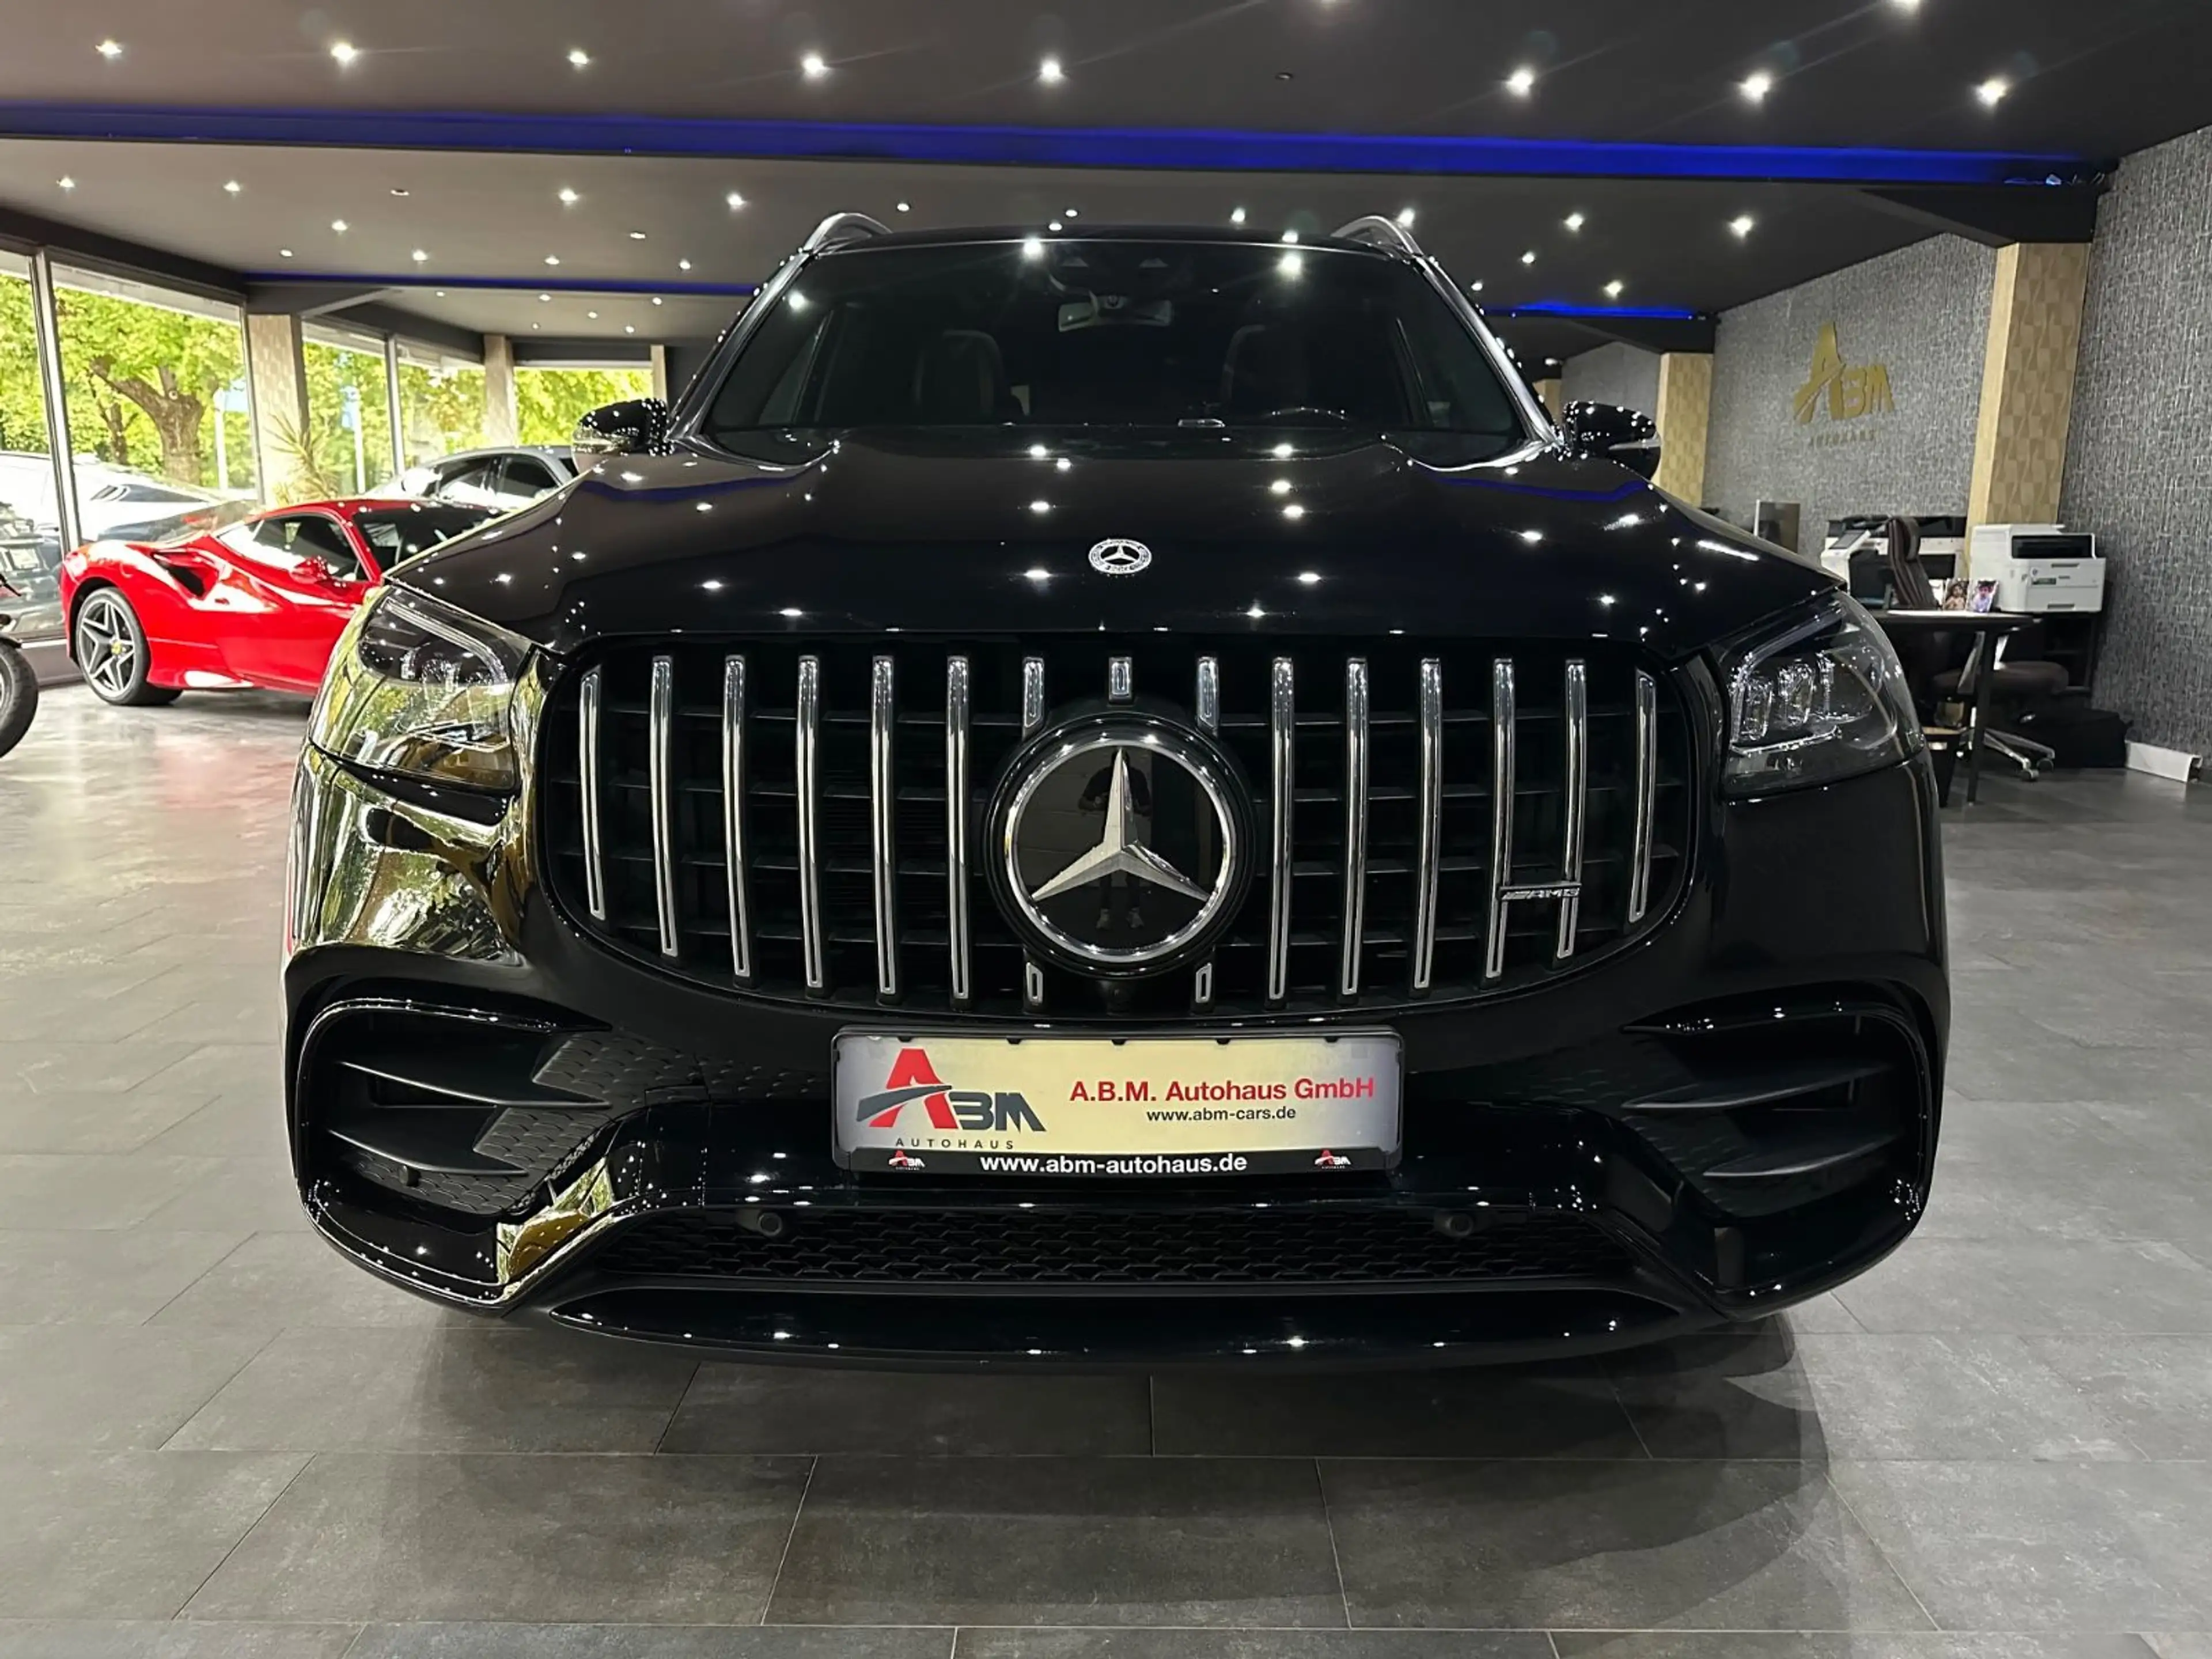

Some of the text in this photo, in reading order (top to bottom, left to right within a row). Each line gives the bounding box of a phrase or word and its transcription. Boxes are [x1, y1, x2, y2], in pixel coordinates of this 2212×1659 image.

[857, 1048, 1046, 1133] ABM
[1070, 1077, 1374, 1101] A.B.M. Autohaus GmbH
[1147, 1106, 1296, 1122] www.abm-cars.de
[896, 1138, 1013, 1150] AUTOHAUS
[980, 1153, 1248, 1174] www.abm-autohaus.de
